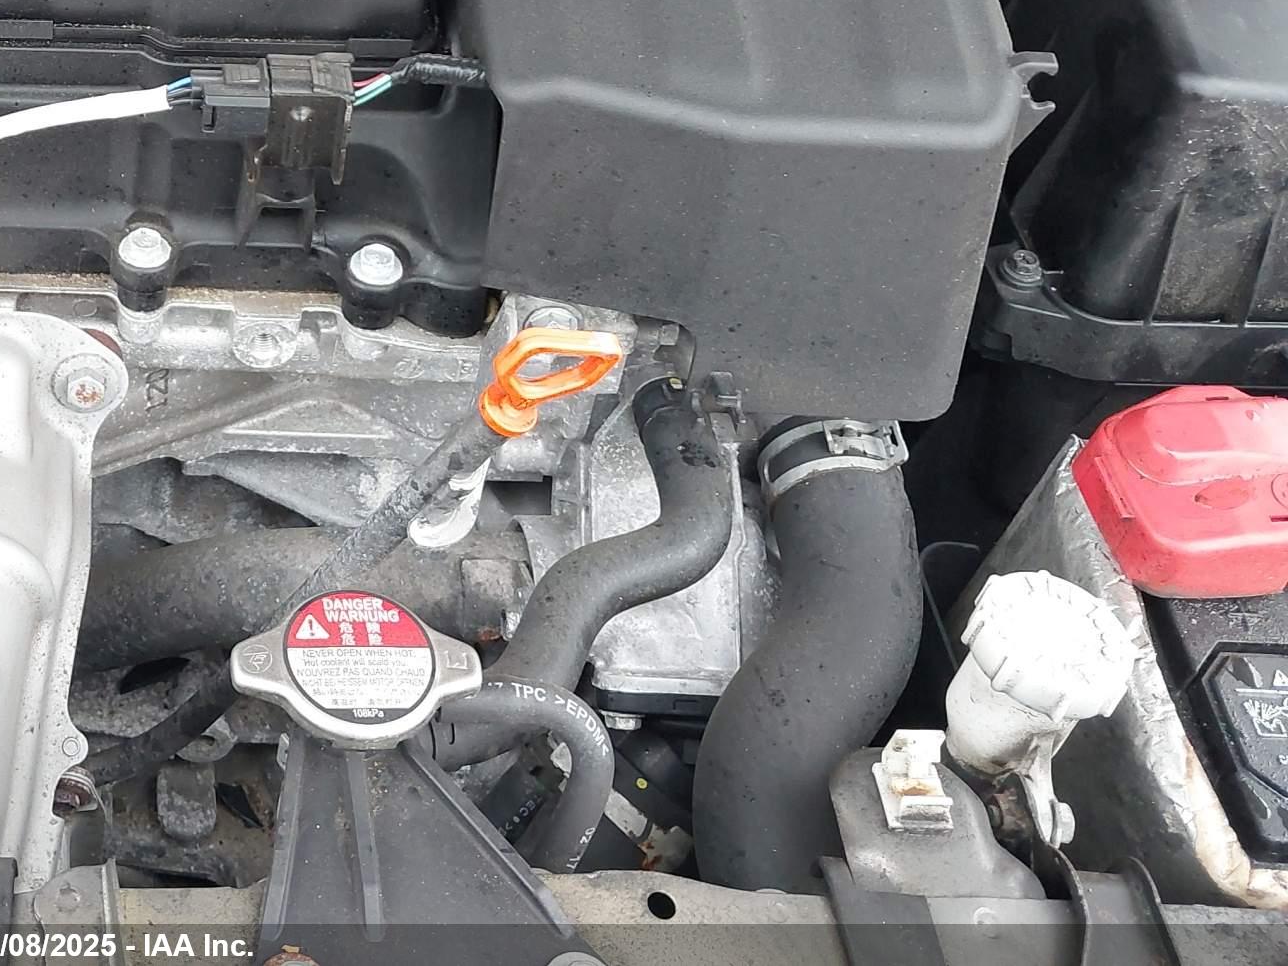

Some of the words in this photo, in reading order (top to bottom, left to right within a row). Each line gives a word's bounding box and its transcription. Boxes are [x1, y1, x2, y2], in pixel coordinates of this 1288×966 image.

[322, 598, 383, 611] DANGER
[325, 609, 401, 623] WARNUNG
[302, 649, 334, 657] NEVER
[337, 649, 362, 657] OPEN
[365, 649, 392, 657] WHEN
[511, 682, 546, 702] TPC
